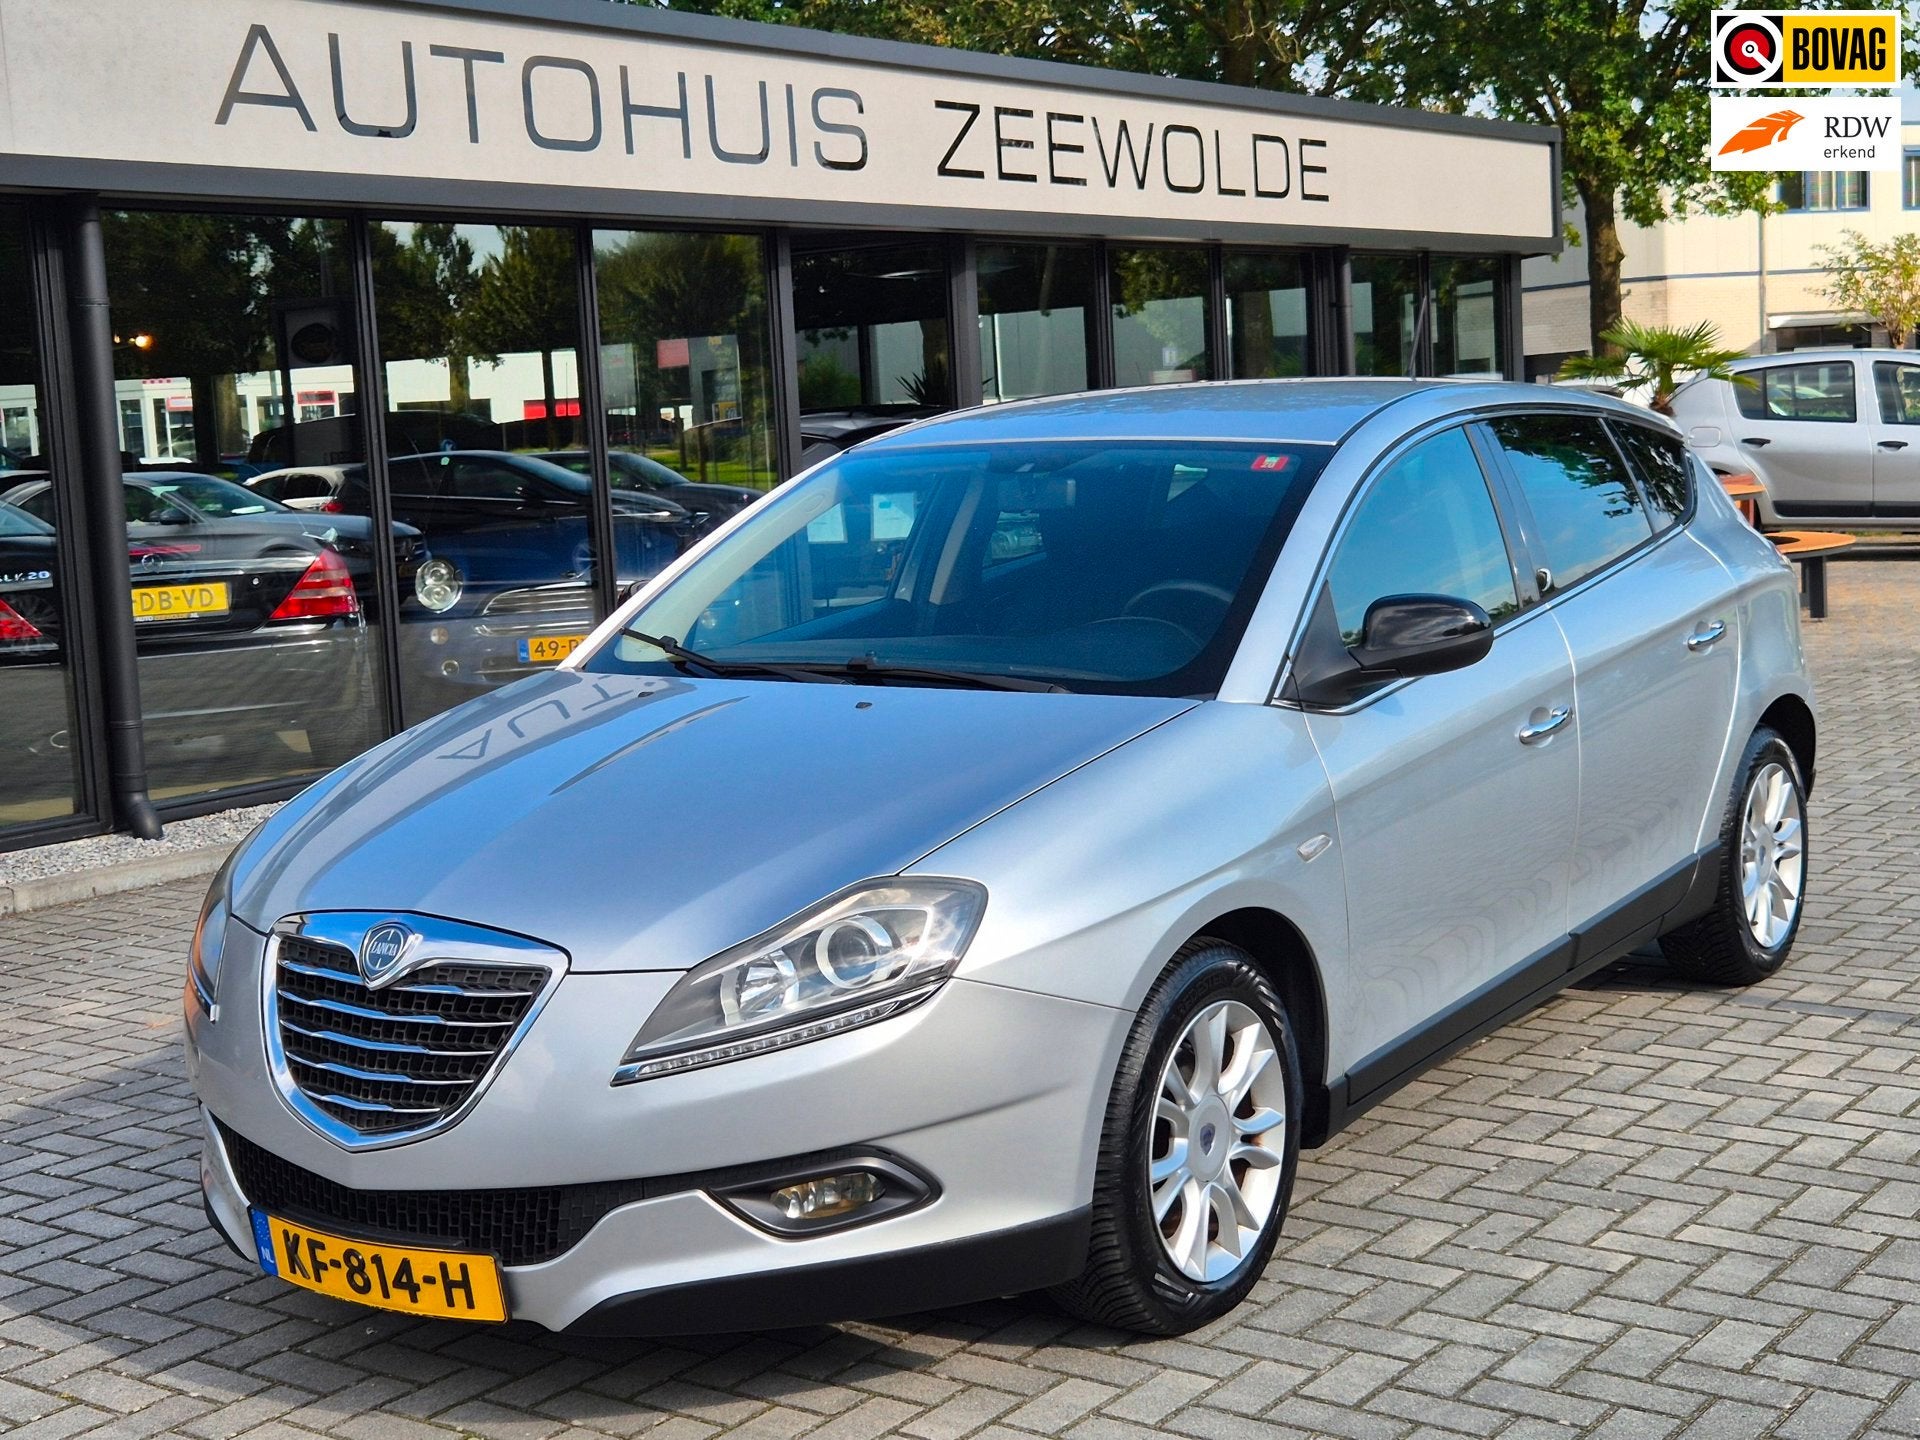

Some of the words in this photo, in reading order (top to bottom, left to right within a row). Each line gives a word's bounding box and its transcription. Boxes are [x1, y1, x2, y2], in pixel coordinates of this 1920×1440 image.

[214, 23, 868, 171] AUTOHUIS
[934, 99, 1330, 202] ZEEWOLDE
[370, 941, 398, 956] LANCIA
[261, 1245, 275, 1264] NL
[282, 1228, 476, 1310] KF-814-H
